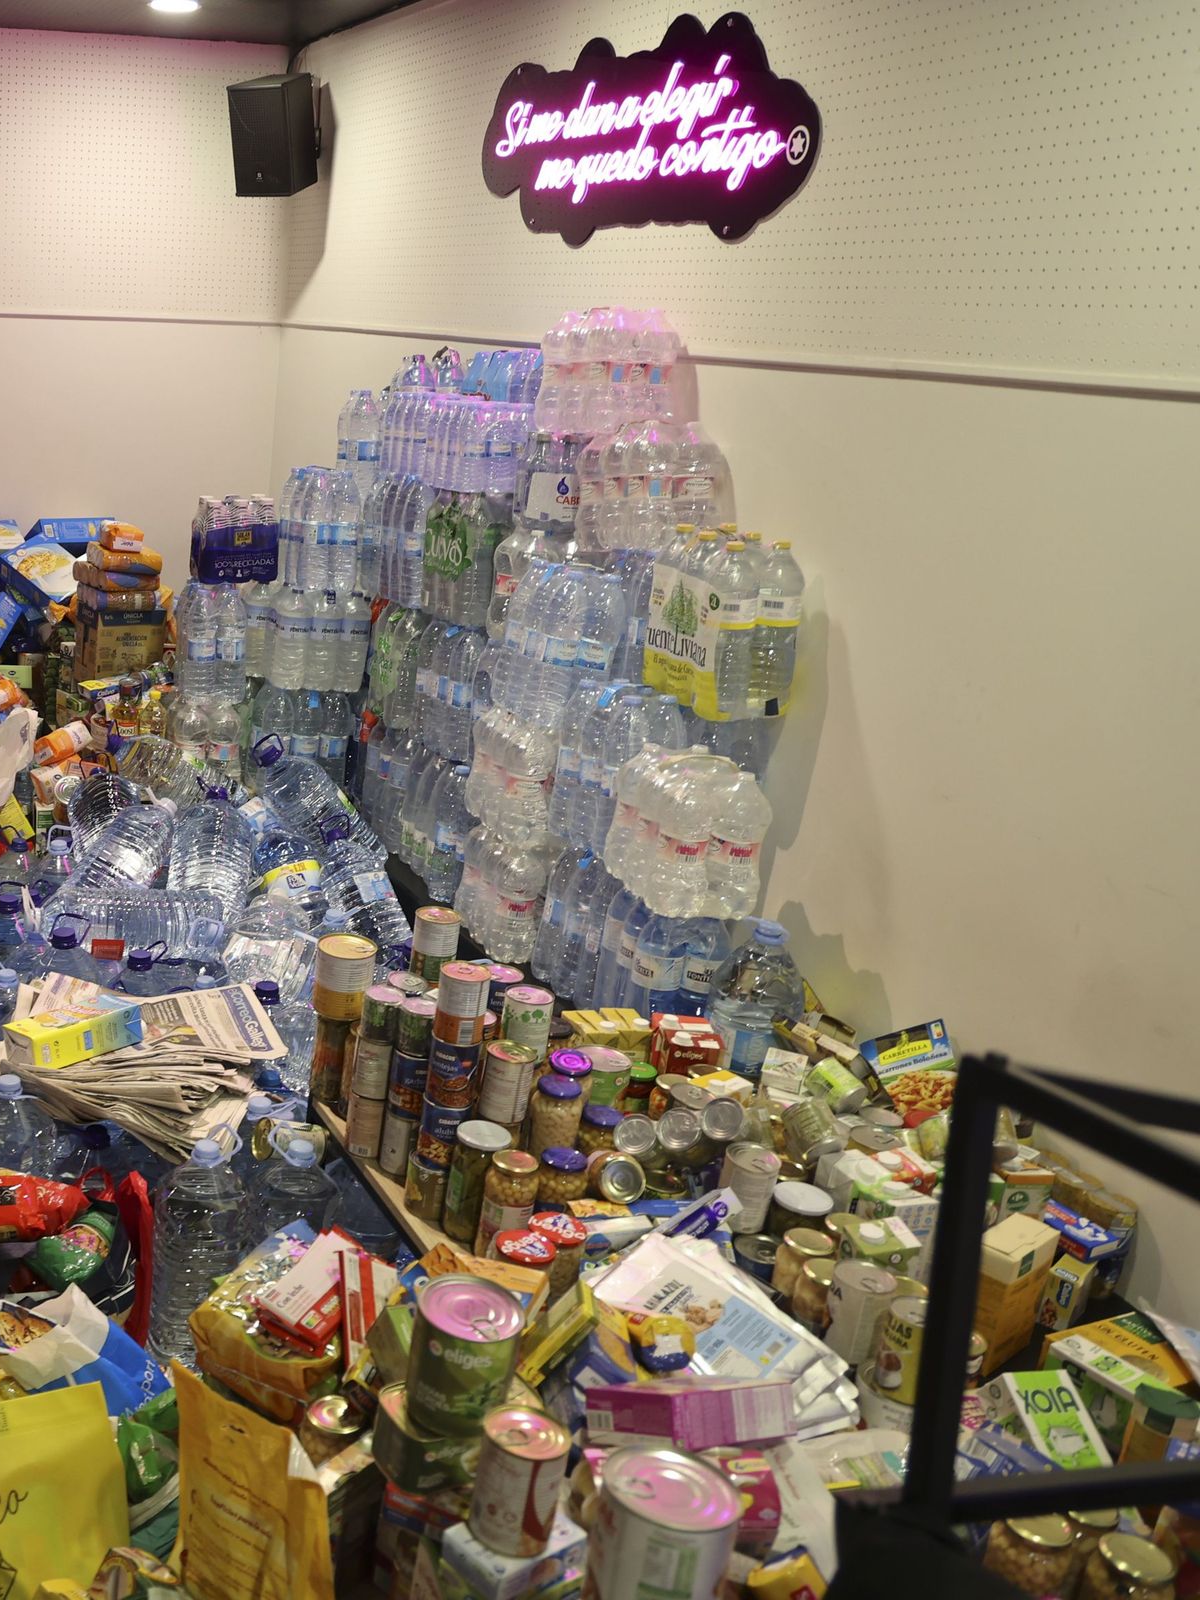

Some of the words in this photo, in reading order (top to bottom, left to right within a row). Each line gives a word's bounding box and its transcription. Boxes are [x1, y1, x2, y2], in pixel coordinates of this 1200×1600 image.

[496, 100, 534, 157] Si
[525, 111, 565, 145] me
[563, 81, 619, 139] dan
[615, 96, 642, 130] a
[534, 158, 575, 190] me
[572, 121, 659, 204] quedo
[659, 106, 787, 191] contigo
[882, 1043, 928, 1061] CARRETILLA
[443, 1348, 493, 1370] eliges
